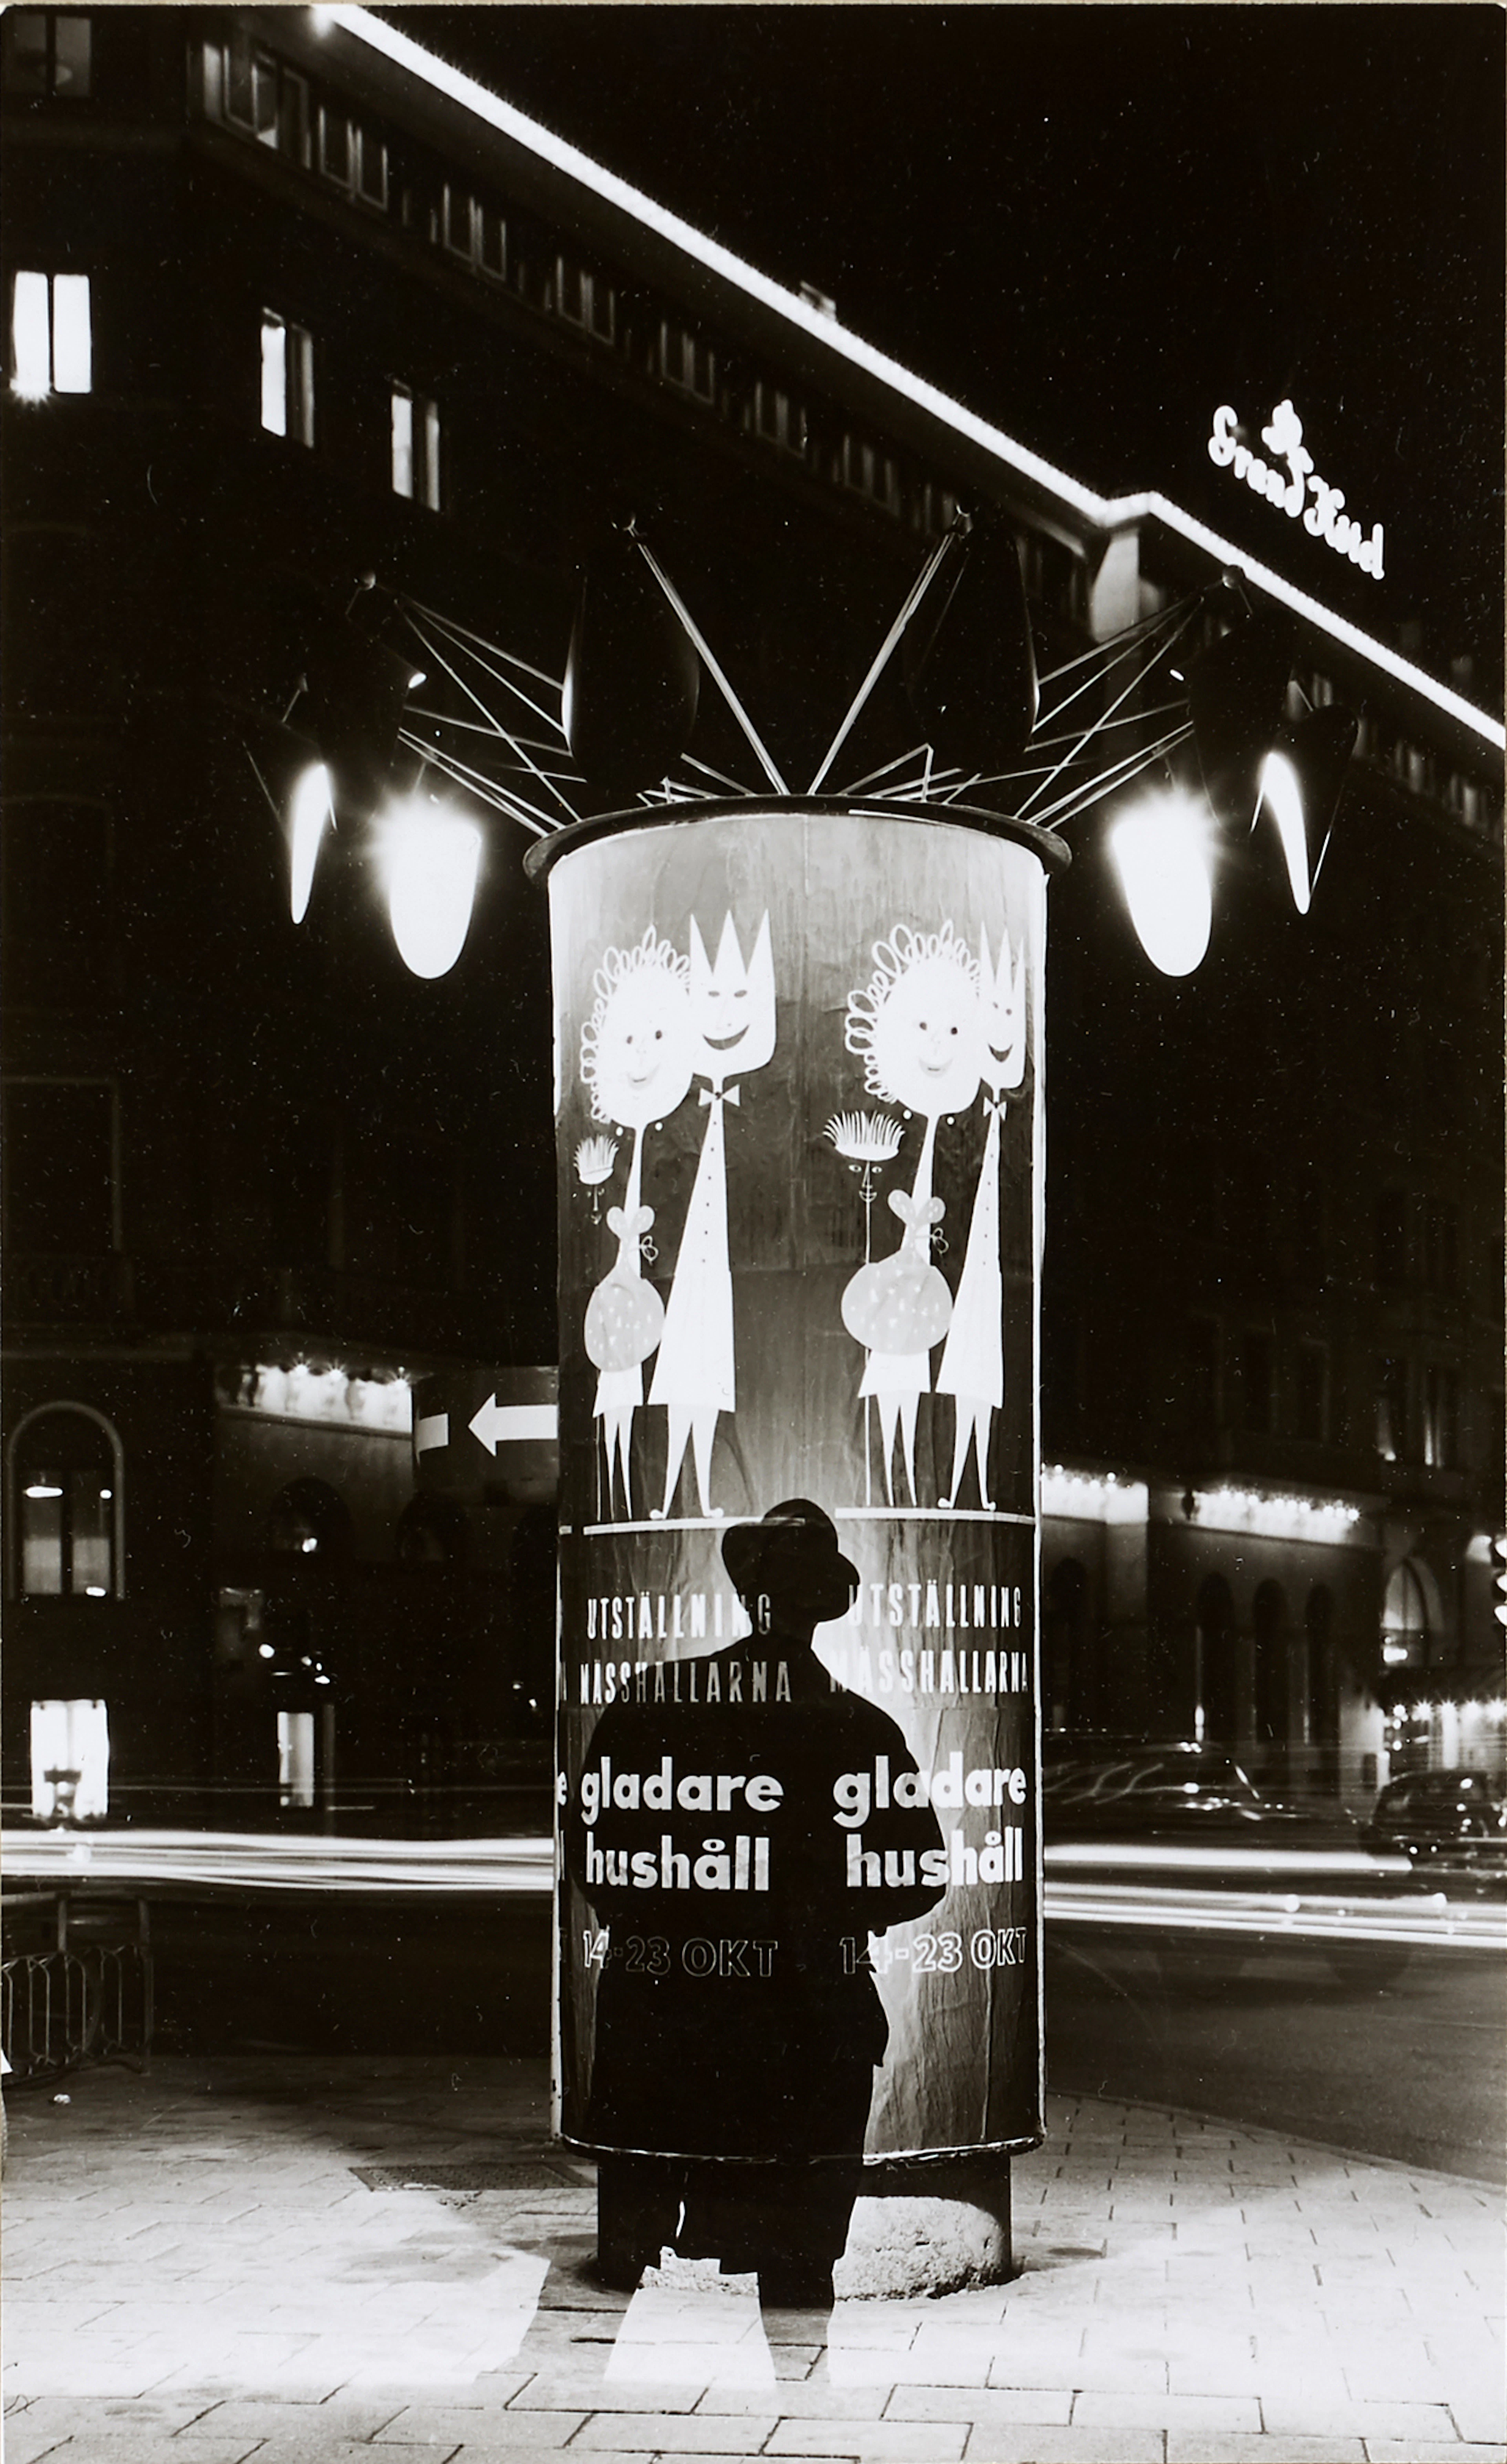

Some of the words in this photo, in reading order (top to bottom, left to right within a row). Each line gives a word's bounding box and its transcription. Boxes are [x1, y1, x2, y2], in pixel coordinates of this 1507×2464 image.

[588, 1592, 771, 1640] UTSTÄLLNING
[848, 1580, 1021, 1628] UTSTÄLLNING
[581, 1756, 784, 1826] gladare
[833, 1751, 1027, 1828] gladare
[586, 1831, 770, 1891] hushåll
[846, 1826, 1023, 1888] hushåll
[682, 1938, 778, 1977] OKT
[971, 1927, 1027, 1969] OKT
